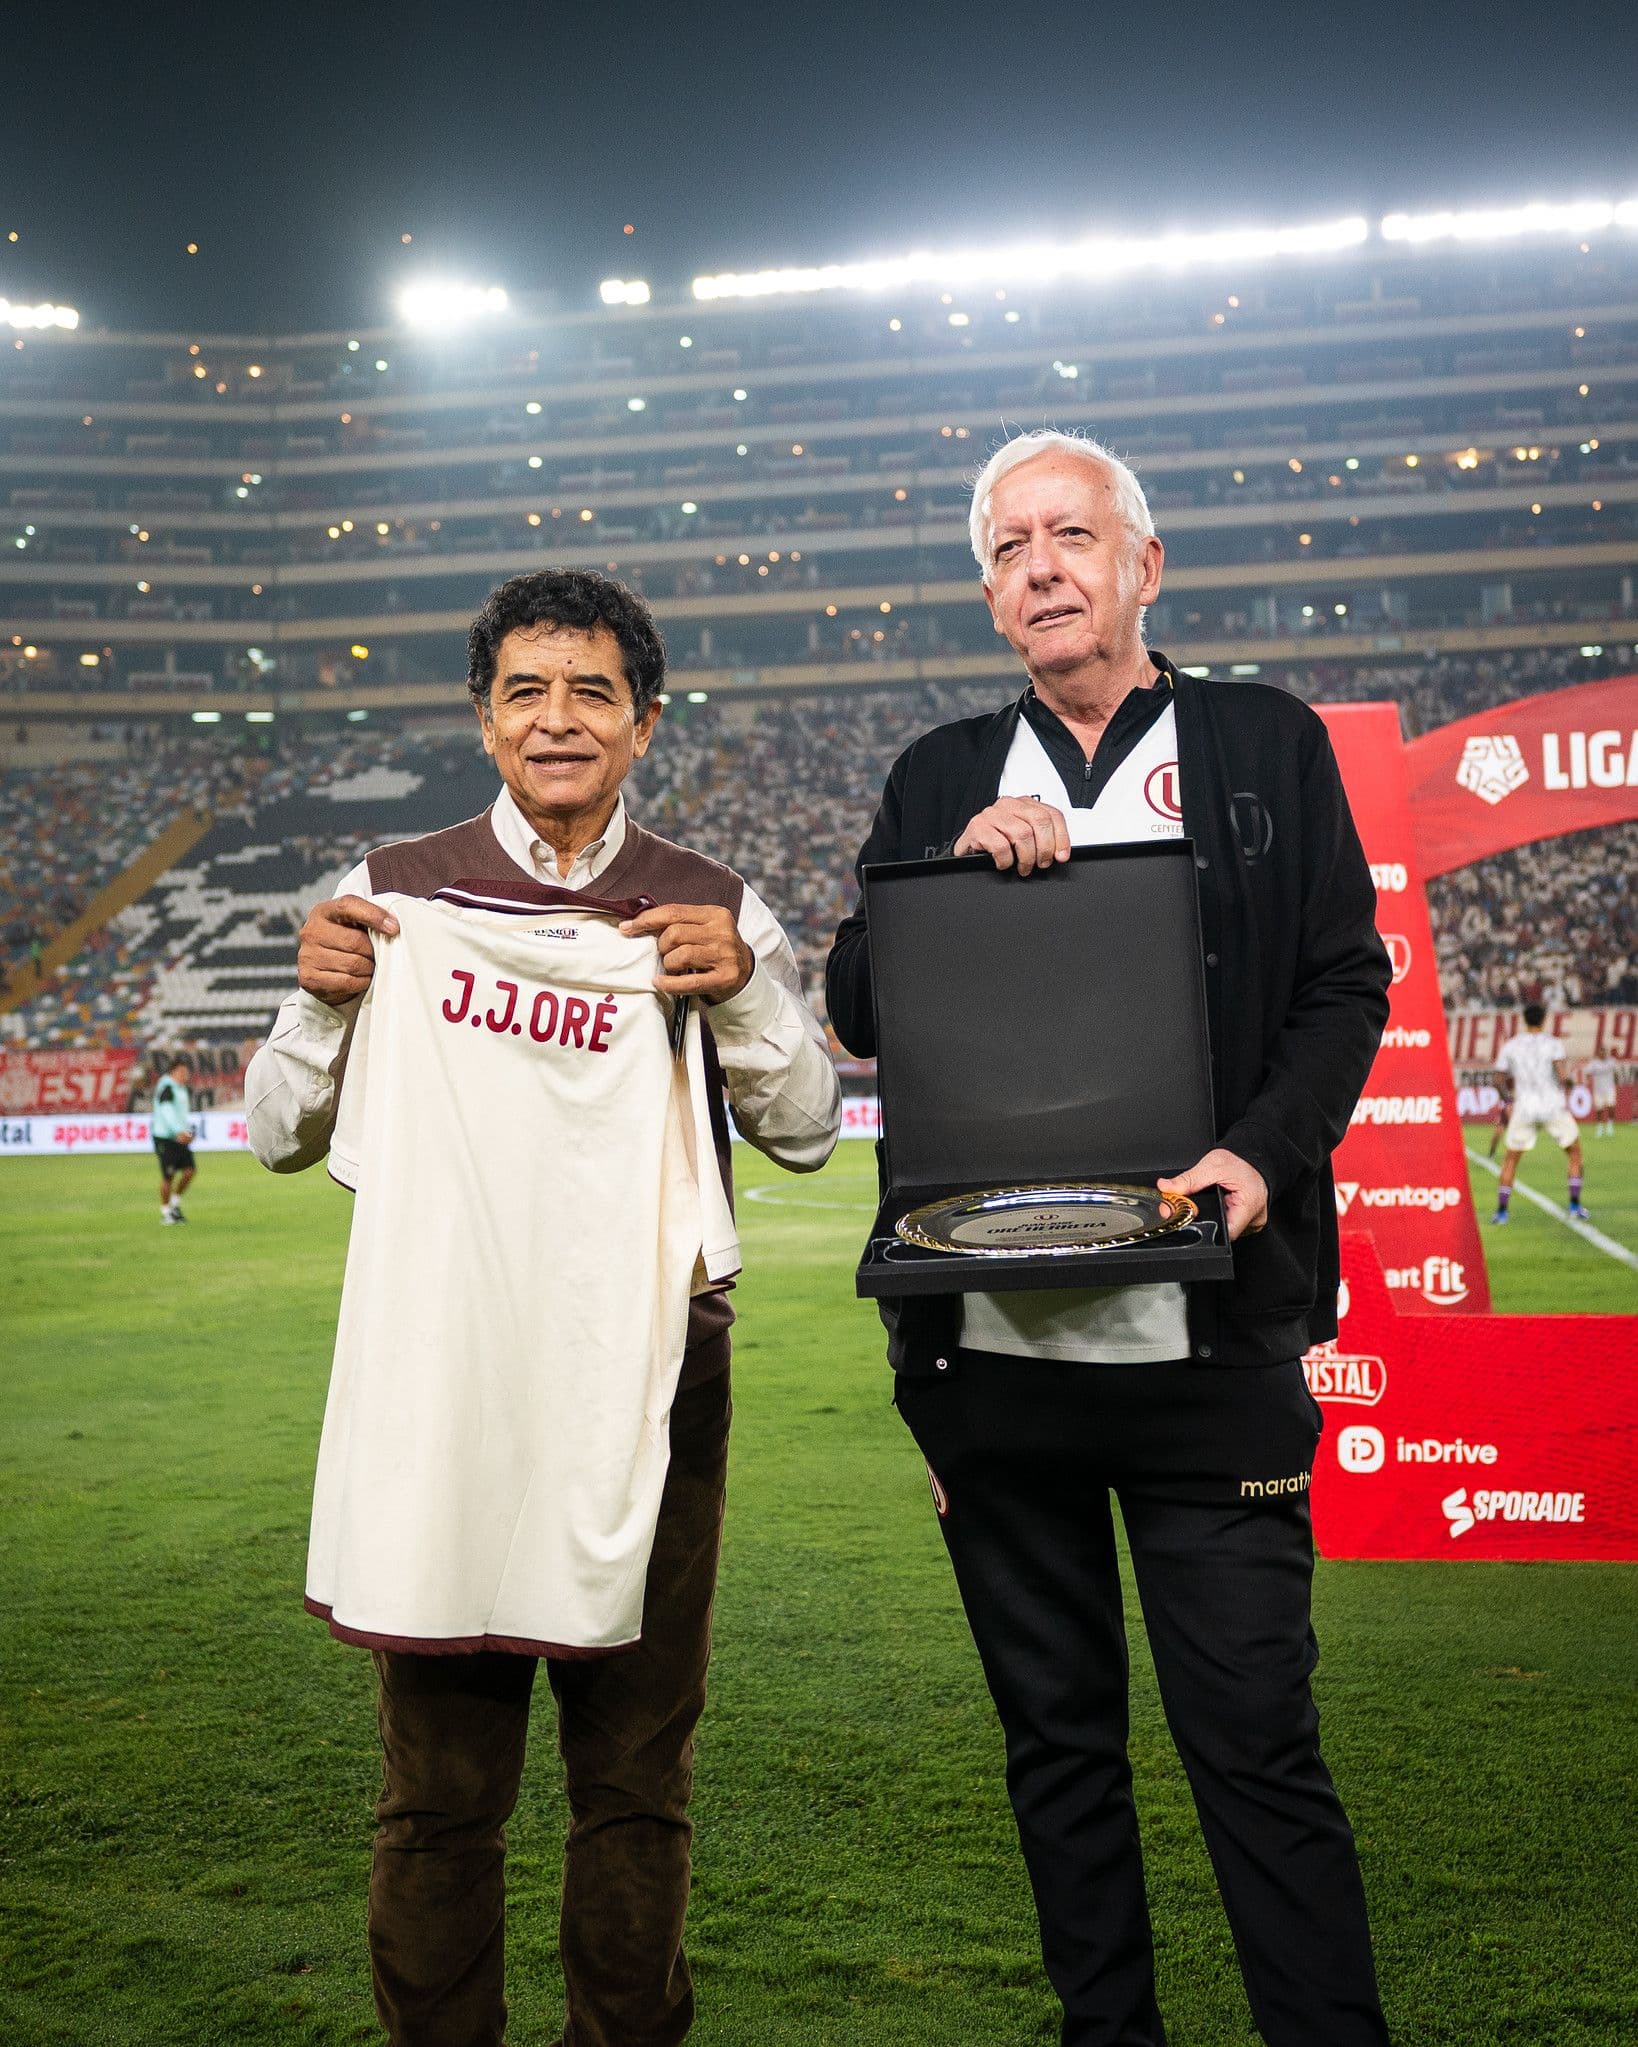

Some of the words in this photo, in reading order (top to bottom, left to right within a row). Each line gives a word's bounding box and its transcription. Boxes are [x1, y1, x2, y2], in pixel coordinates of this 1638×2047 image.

[442, 969, 618, 1053] J.J.ORÉ
[1360, 1184, 1461, 1212] vantage
[1424, 1255, 1466, 1293] fit
[1397, 1437, 1498, 1464] inDrive
[1473, 1490, 1585, 1523] SPORADE
